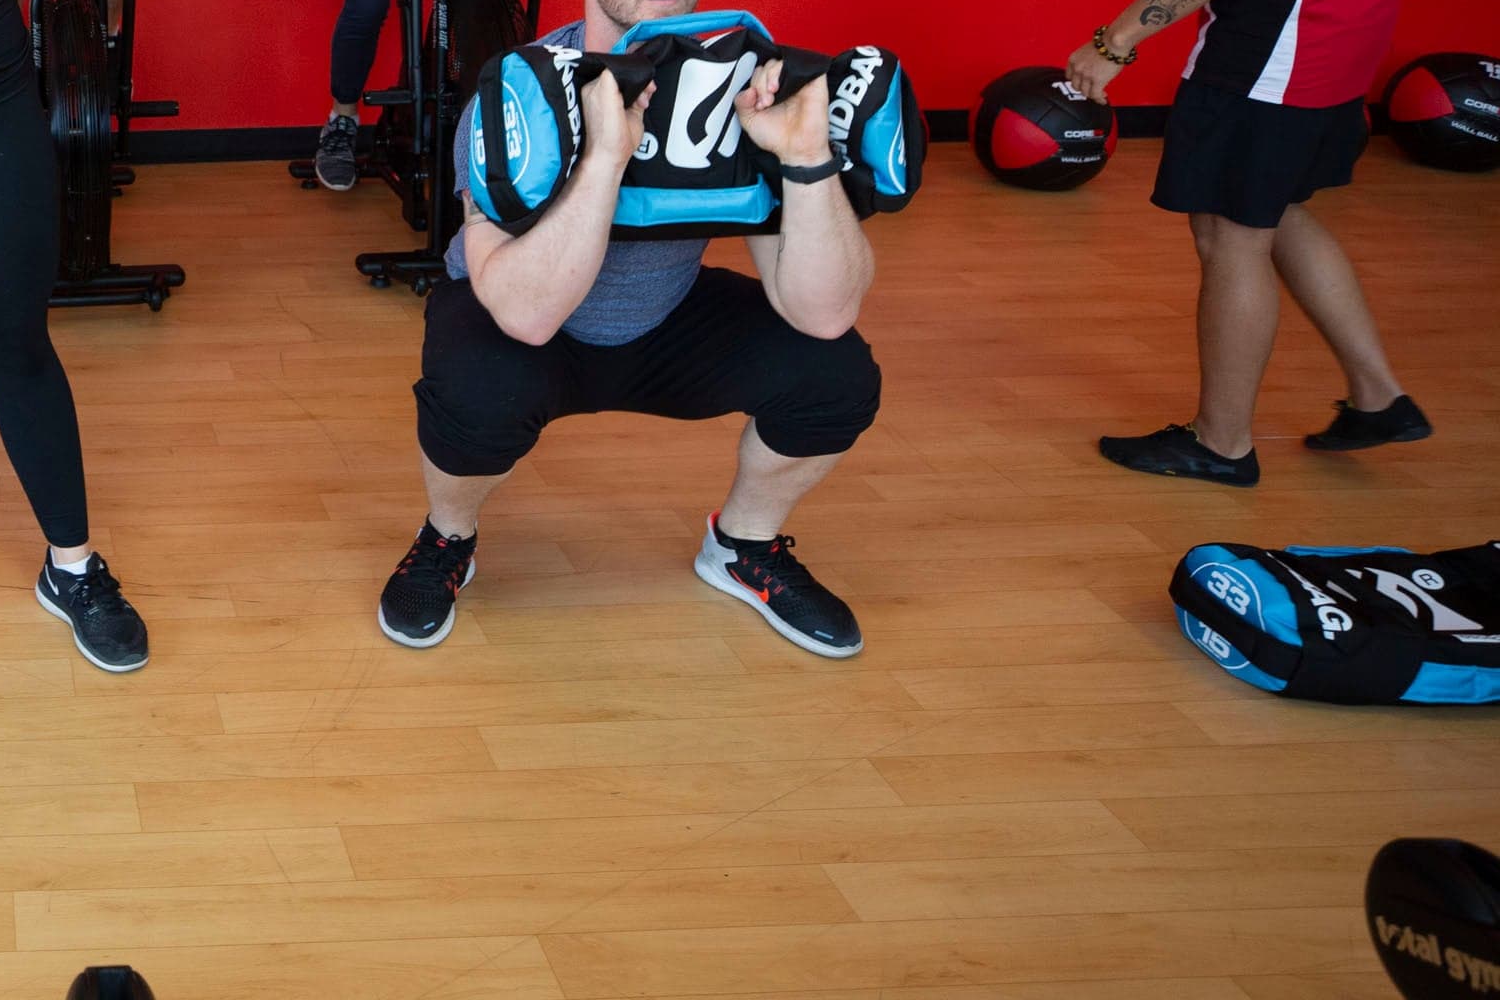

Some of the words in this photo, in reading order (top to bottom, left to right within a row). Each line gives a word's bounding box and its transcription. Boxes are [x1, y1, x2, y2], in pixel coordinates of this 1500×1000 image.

[503, 100, 522, 160] 33
[1207, 570, 1251, 615] 33
[1199, 621, 1232, 658] 15
